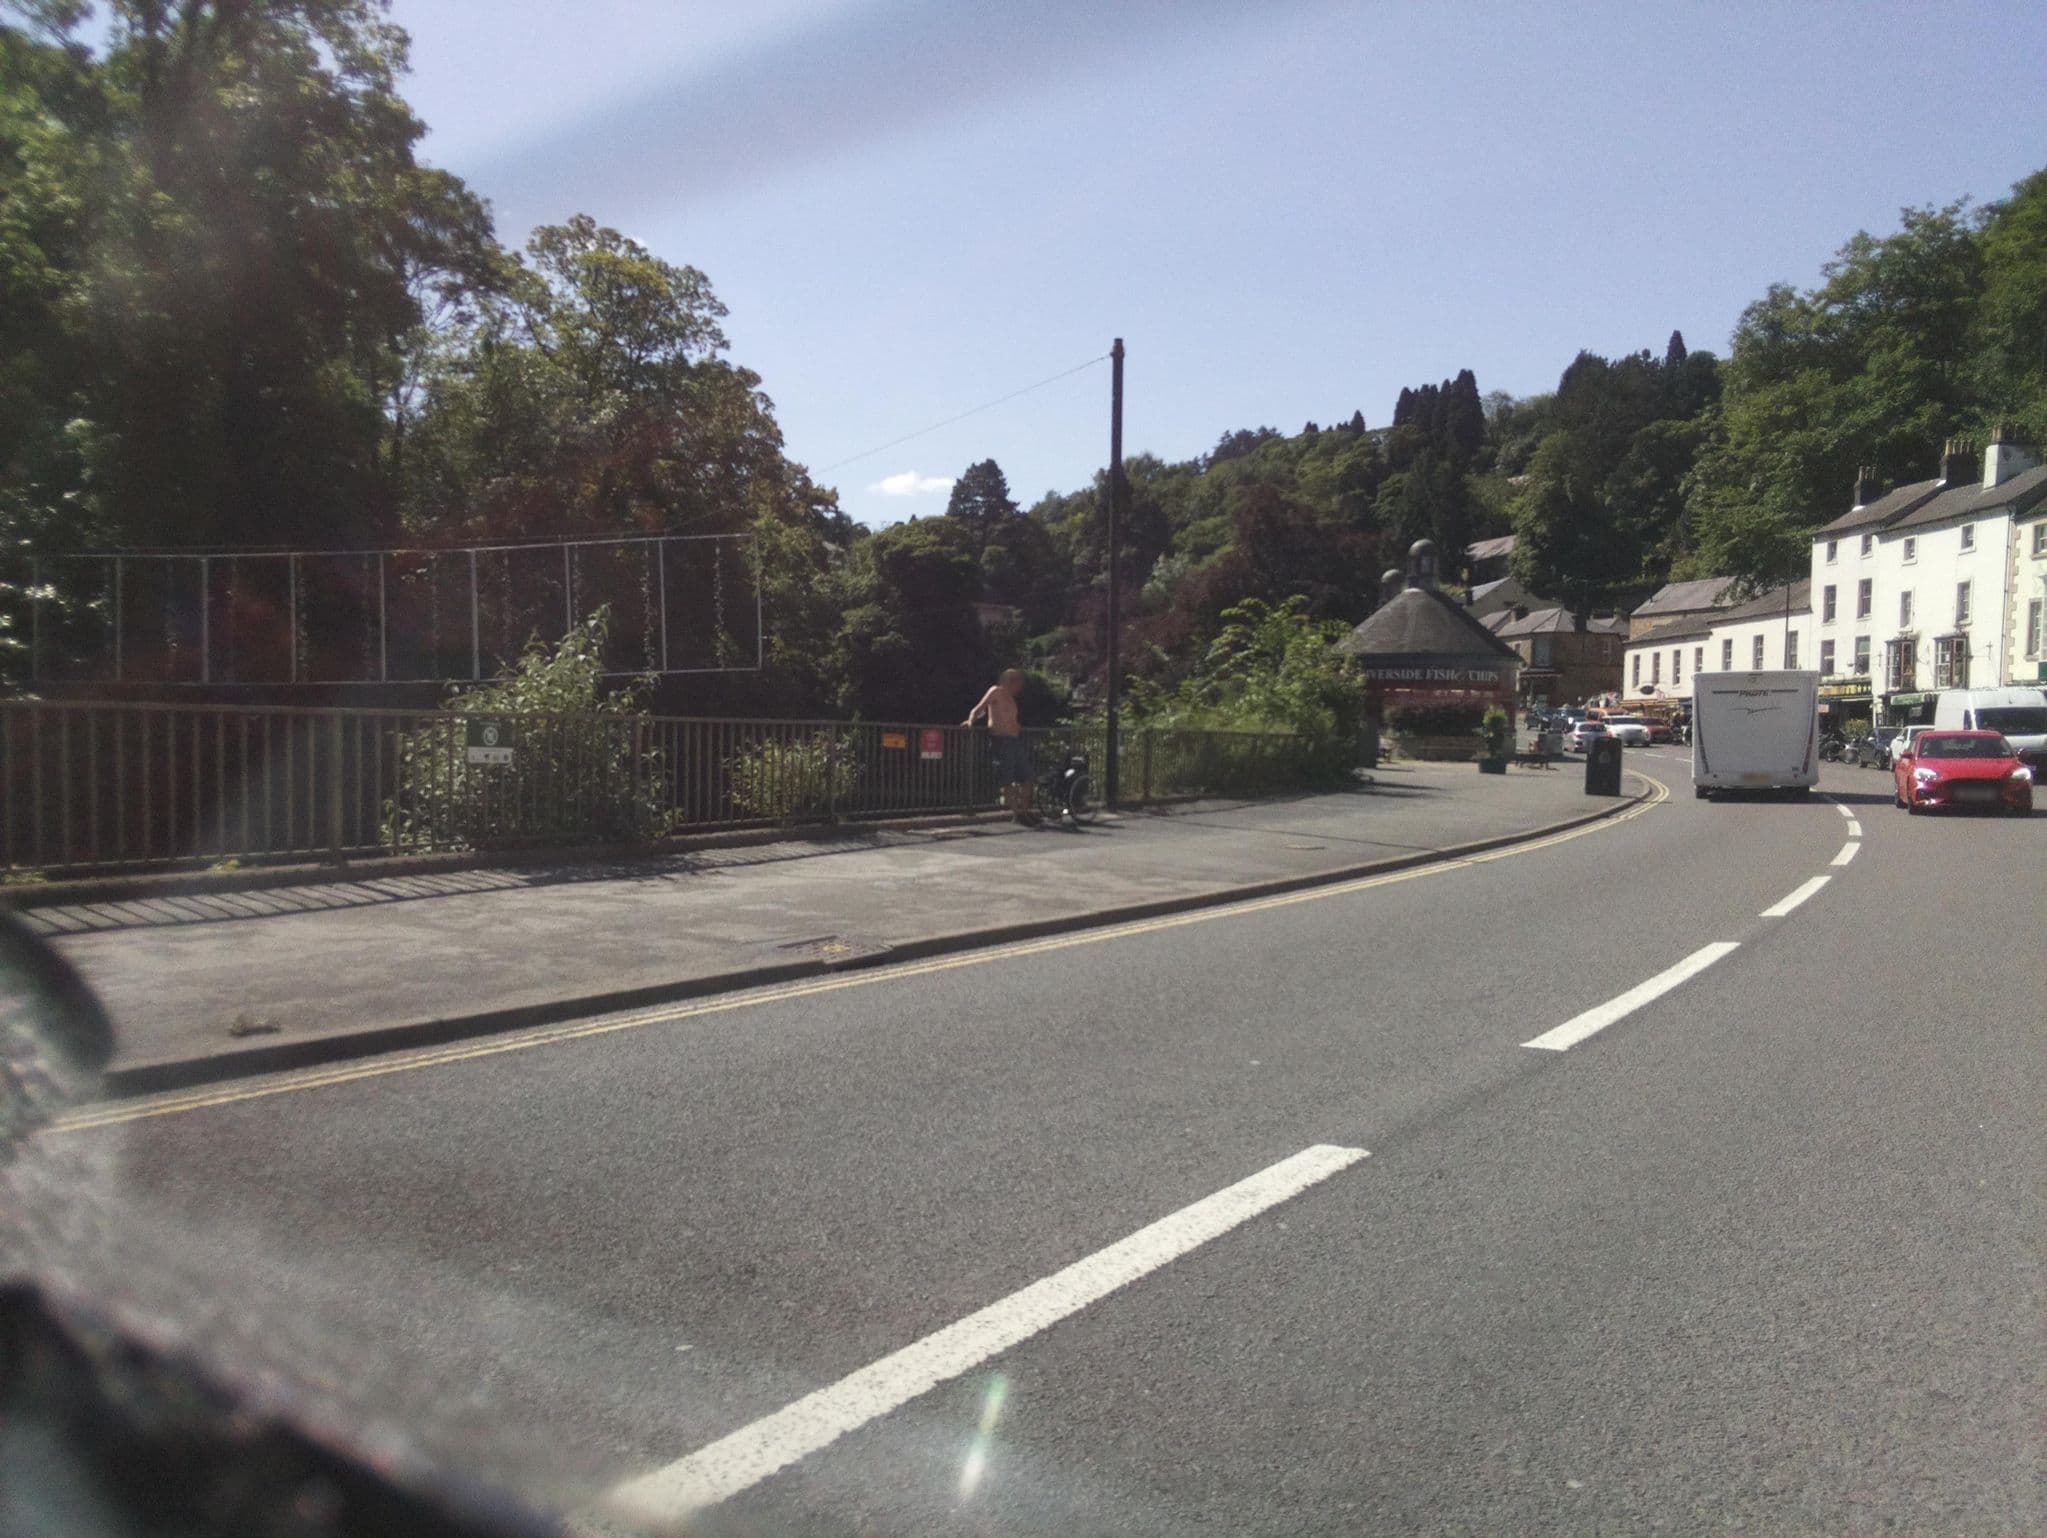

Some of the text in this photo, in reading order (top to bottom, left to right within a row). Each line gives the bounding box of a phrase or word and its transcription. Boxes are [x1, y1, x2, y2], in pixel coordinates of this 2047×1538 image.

[1365, 669, 1423, 680] IVERSIDE
[1425, 669, 1456, 680] FISH
[1468, 670, 1499, 681] CHIPS
